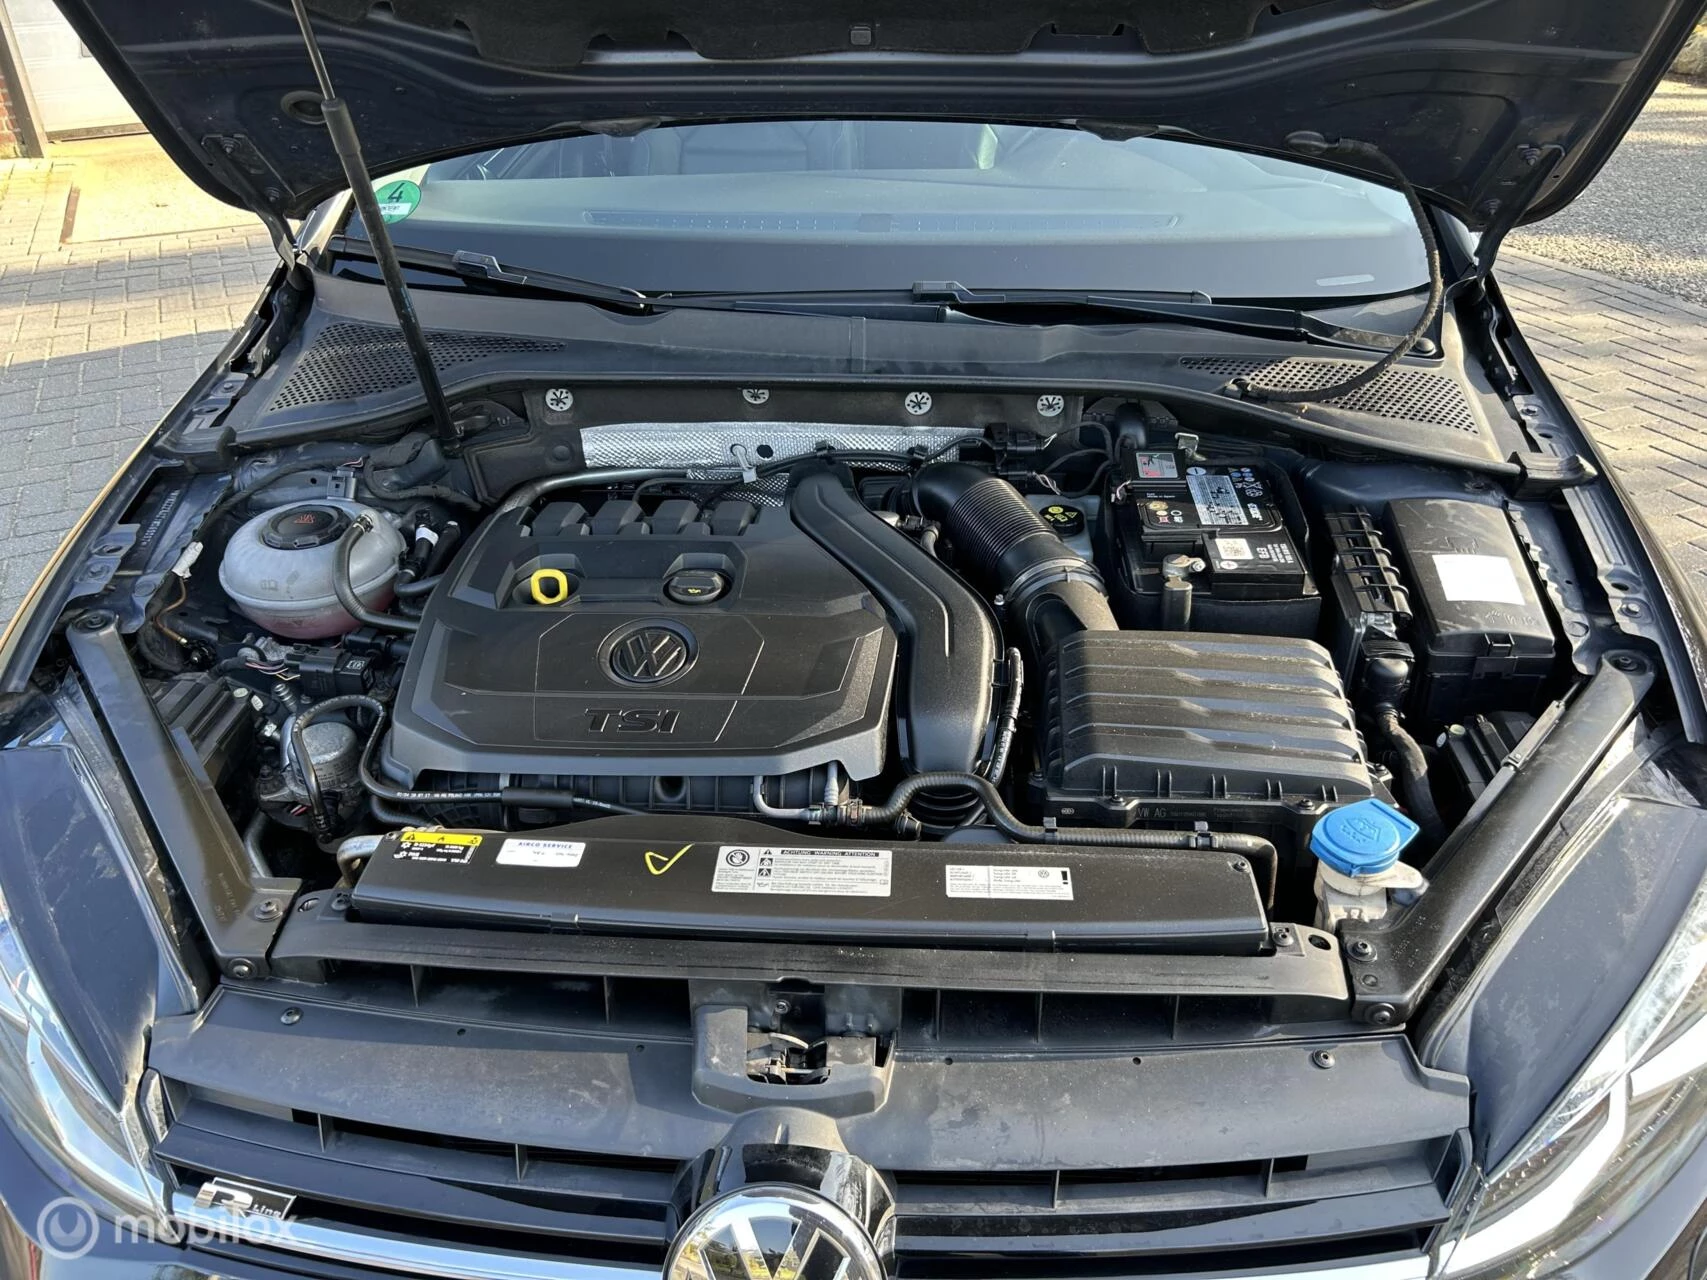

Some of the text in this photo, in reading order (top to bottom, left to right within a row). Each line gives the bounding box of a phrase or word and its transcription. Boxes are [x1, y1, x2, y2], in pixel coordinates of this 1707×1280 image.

[387, 182, 405, 203] 4
[585, 708, 681, 734] TSI
[1138, 808, 1150, 817] VW
[1154, 808, 1167, 818] AG
[193, 1182, 282, 1219] R Line
